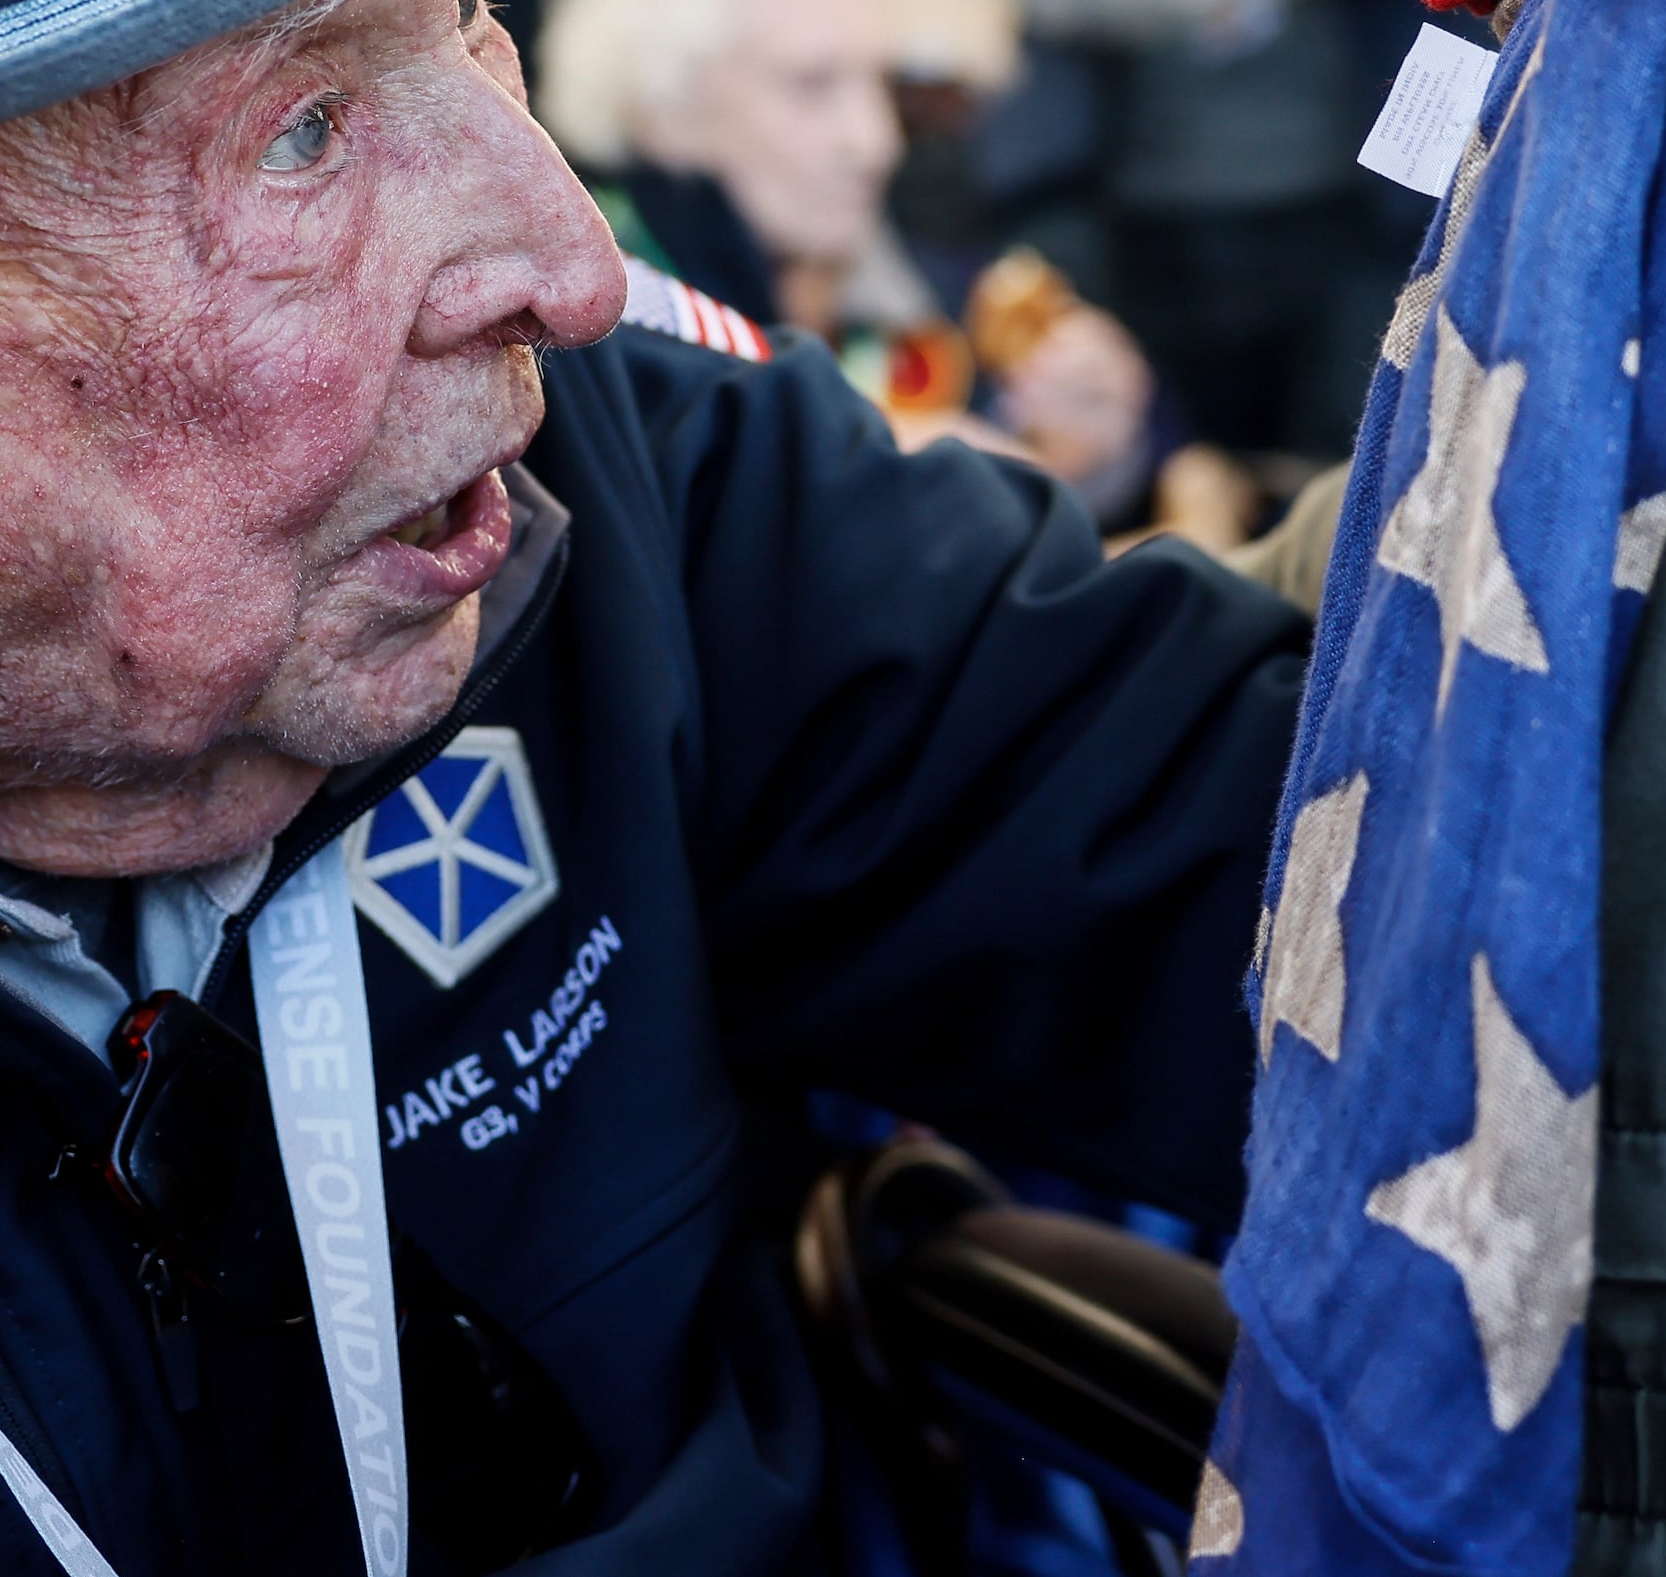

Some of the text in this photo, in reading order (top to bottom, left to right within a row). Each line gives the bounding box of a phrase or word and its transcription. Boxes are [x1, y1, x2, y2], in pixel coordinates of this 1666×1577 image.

[384, 915, 624, 1150] JAKE LARSON
[514, 1076, 540, 1113] V
[543, 999, 611, 1092] CORPS
